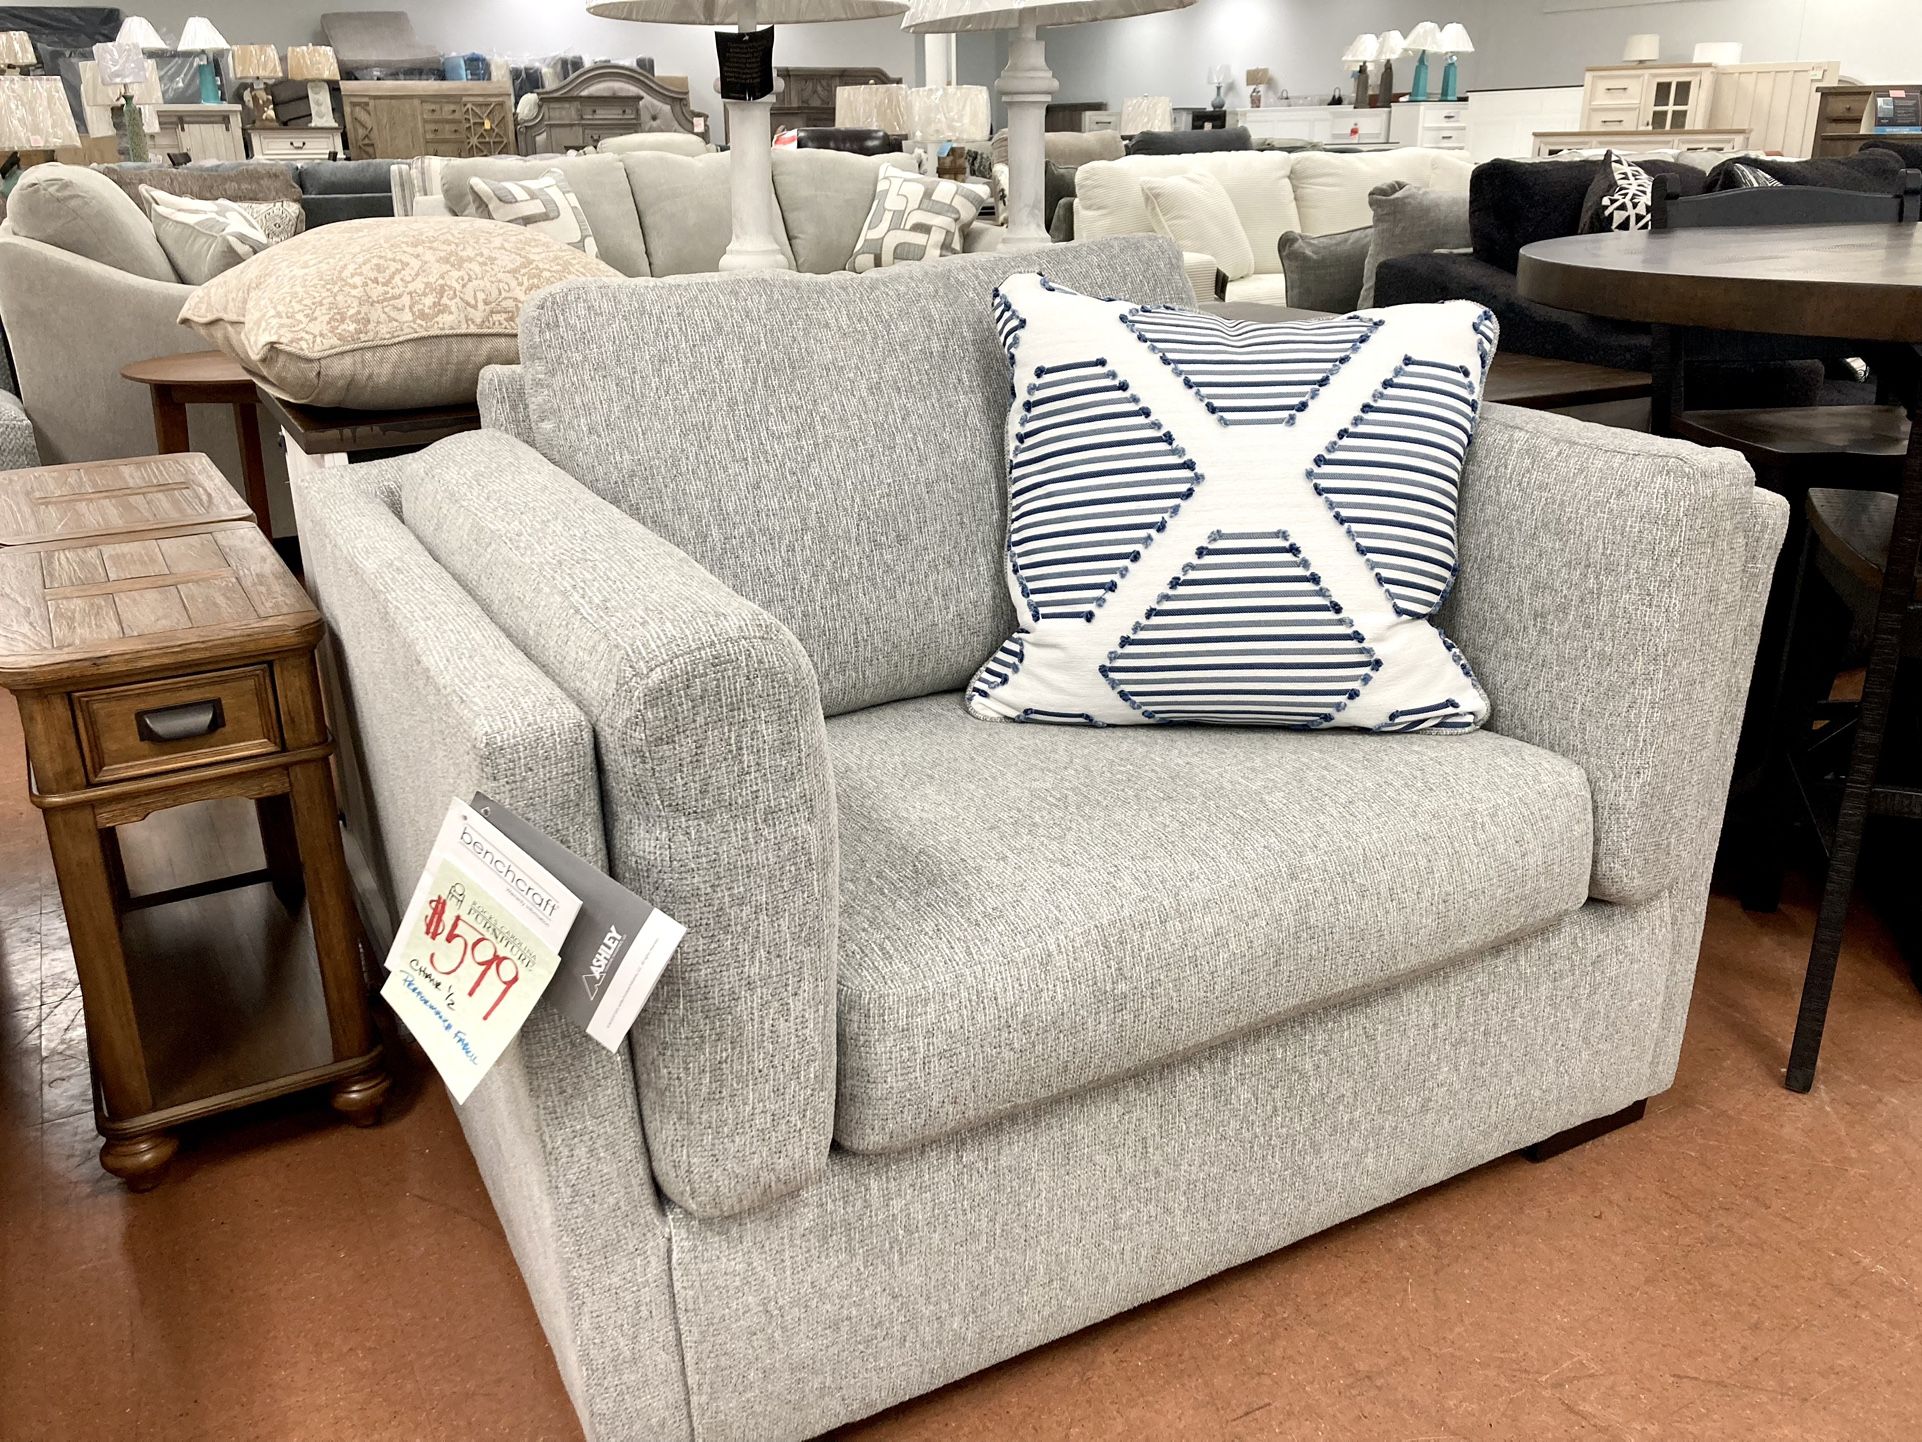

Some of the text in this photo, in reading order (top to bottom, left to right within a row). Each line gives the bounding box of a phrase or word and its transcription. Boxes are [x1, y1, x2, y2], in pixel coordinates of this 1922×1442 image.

[460, 827, 557, 917] benchcraft
[424, 894, 519, 1020] $599
[590, 924, 622, 980] ASHLEY
[445, 985, 455, 1011] 1/2
